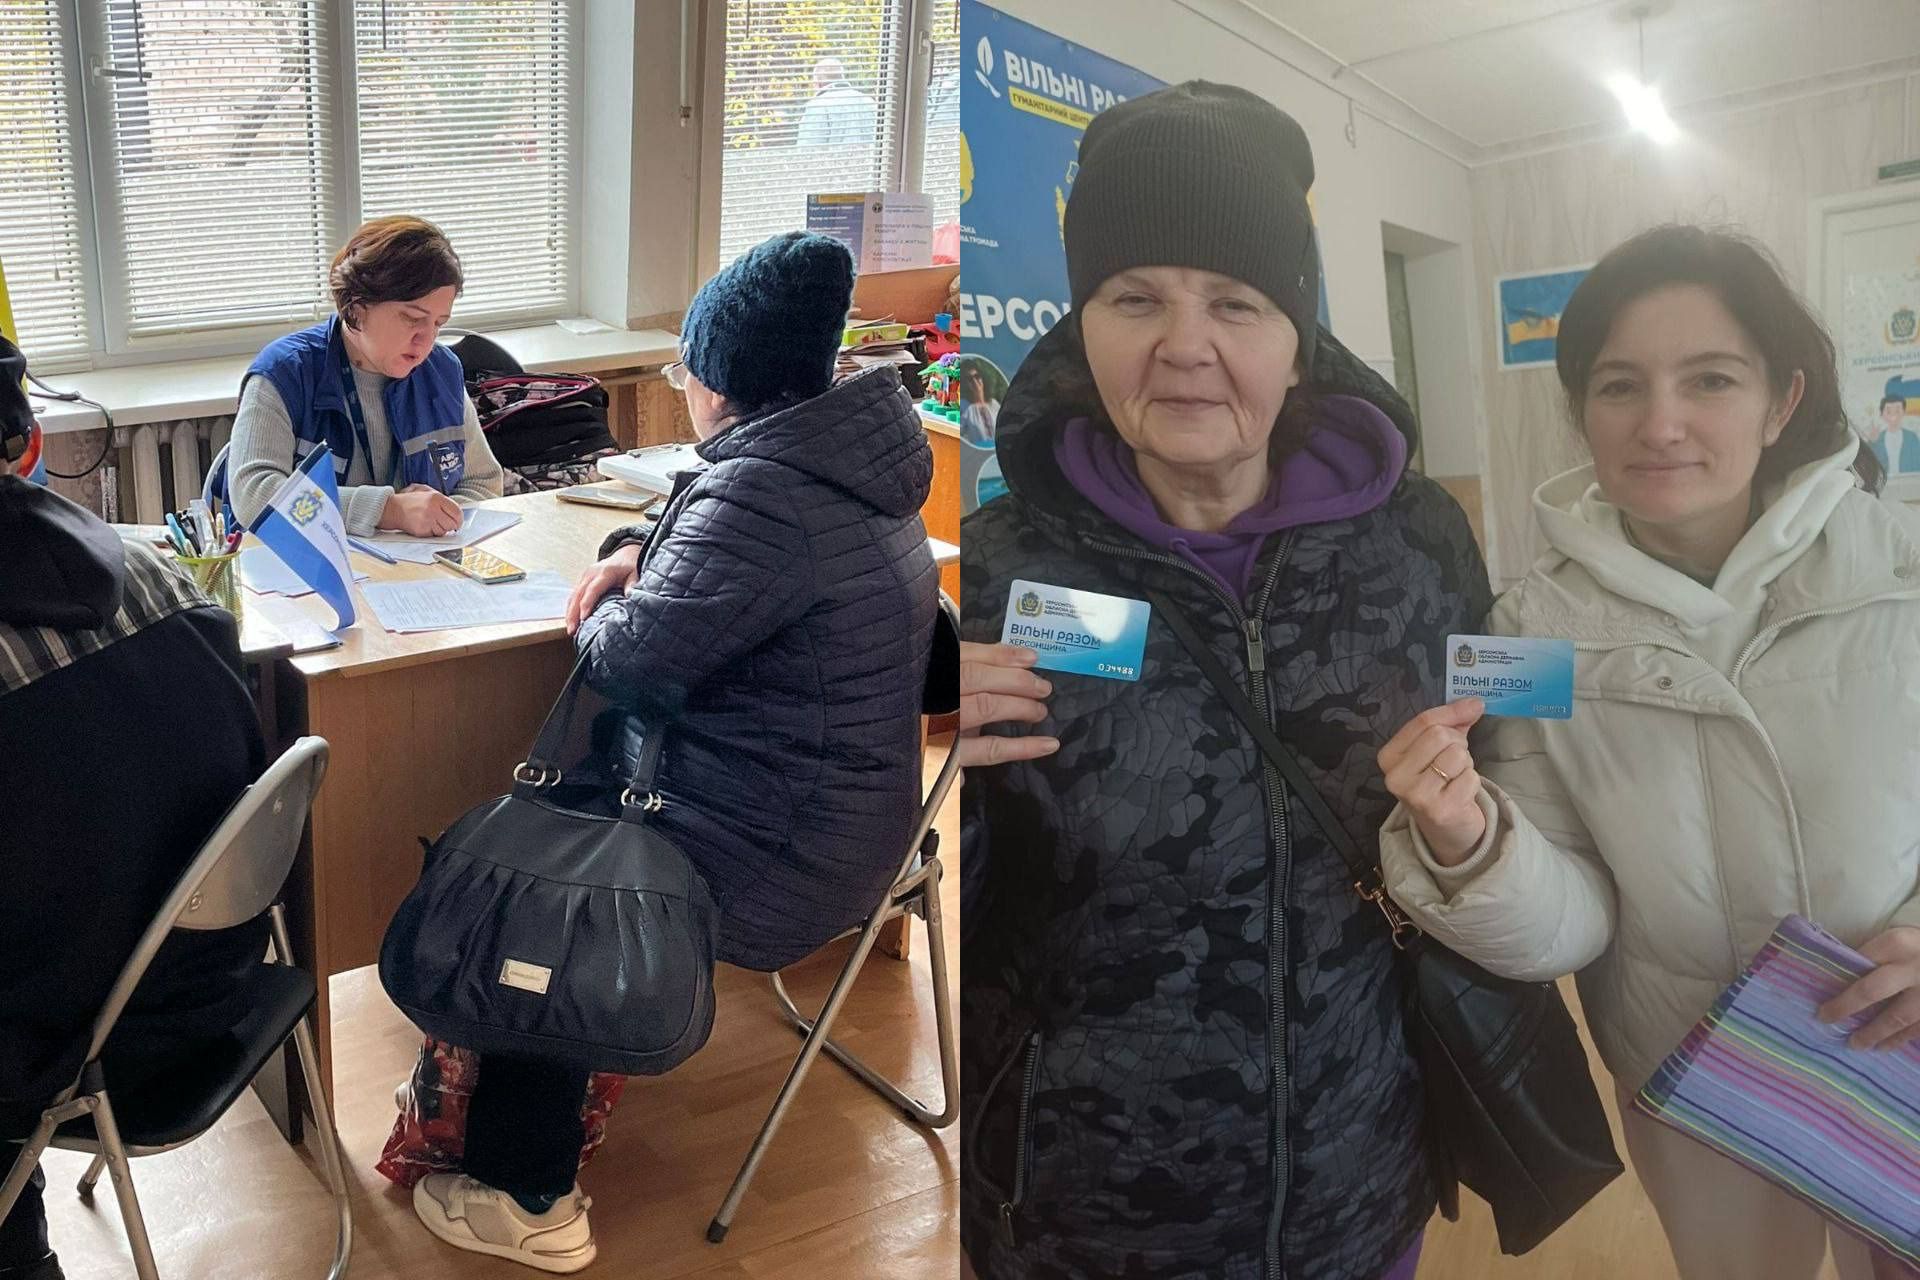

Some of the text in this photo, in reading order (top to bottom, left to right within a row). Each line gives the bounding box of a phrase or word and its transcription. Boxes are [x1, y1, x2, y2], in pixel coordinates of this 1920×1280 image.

[1003, 49, 1088, 108] ВІЛЬНІ
[960, 293, 1071, 341] ЕРСО
[1010, 623, 1101, 647] ВІЛЬНІ РАЗОМ
[1009, 639, 1066, 652] ХЕРСОНЩИНА
[1452, 675, 1534, 689] ВІЛЬНІ РАЗОМ
[1453, 689, 1504, 698] ХЕРСОНЩИНА
